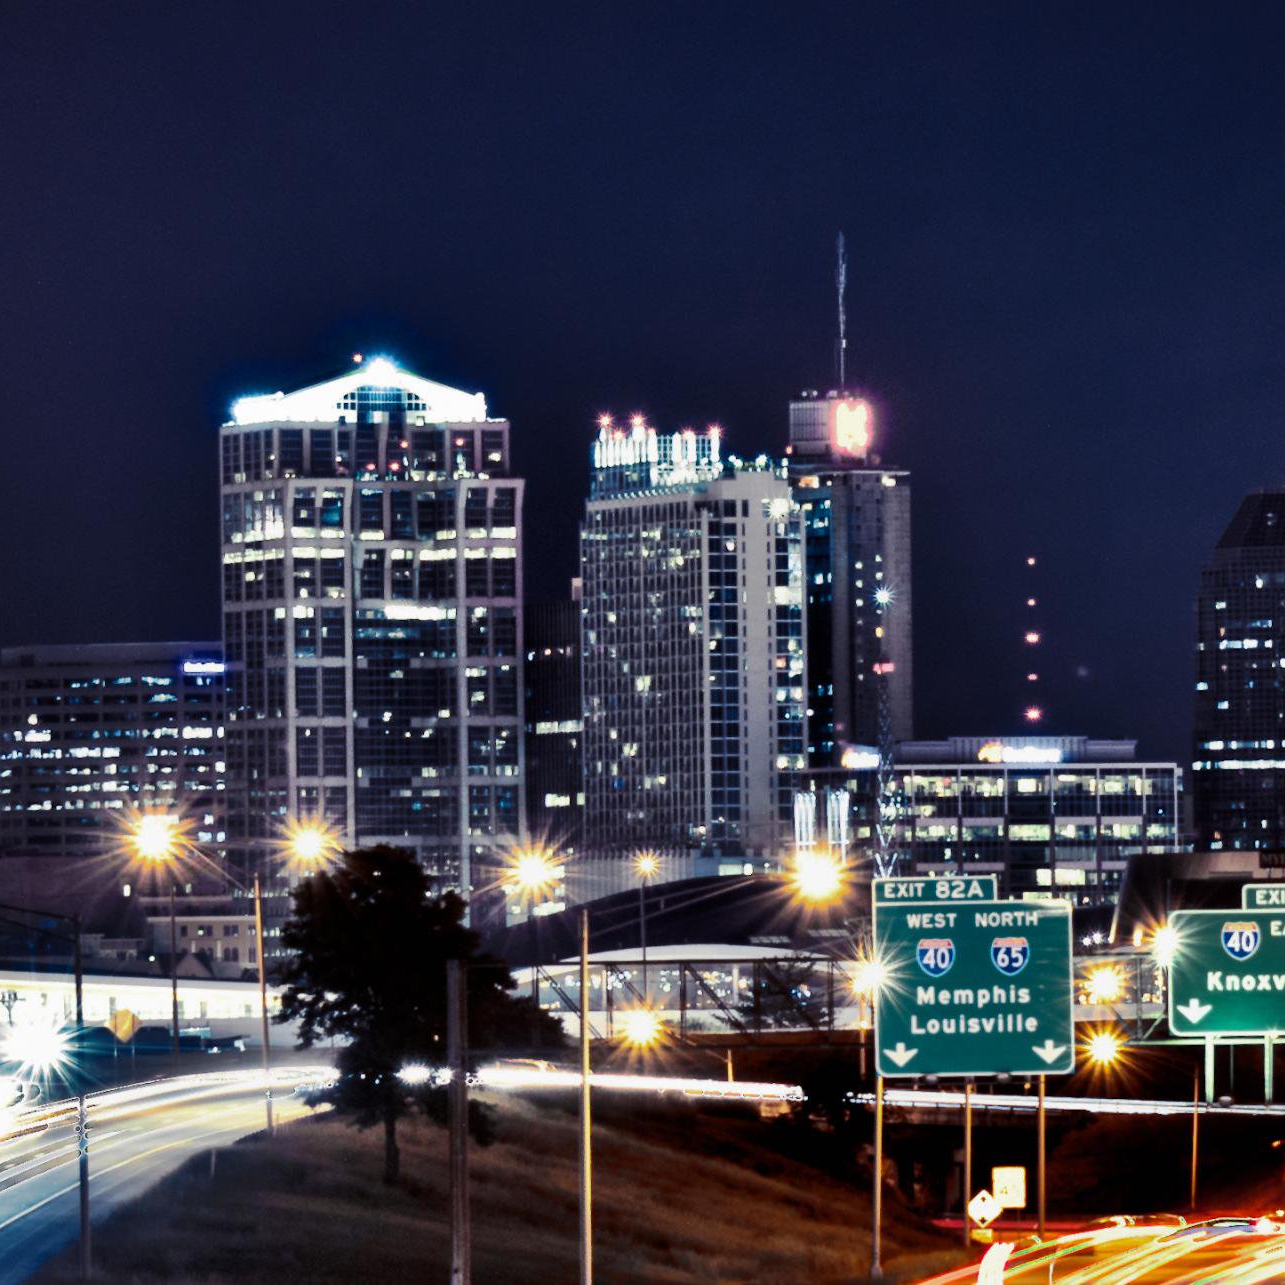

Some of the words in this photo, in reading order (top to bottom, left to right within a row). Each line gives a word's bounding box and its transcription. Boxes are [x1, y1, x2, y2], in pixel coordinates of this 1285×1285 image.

[884, 882, 925, 899] EXIT
[936, 880, 984, 899] 82A
[907, 913, 957, 928] WEST
[975, 911, 1038, 927] NORTH
[1227, 931, 1255, 952] 40
[922, 948, 950, 969] 40
[996, 947, 1024, 968] 65
[916, 985, 1031, 1008] Memphis
[910, 1013, 1038, 1034] Louisville
